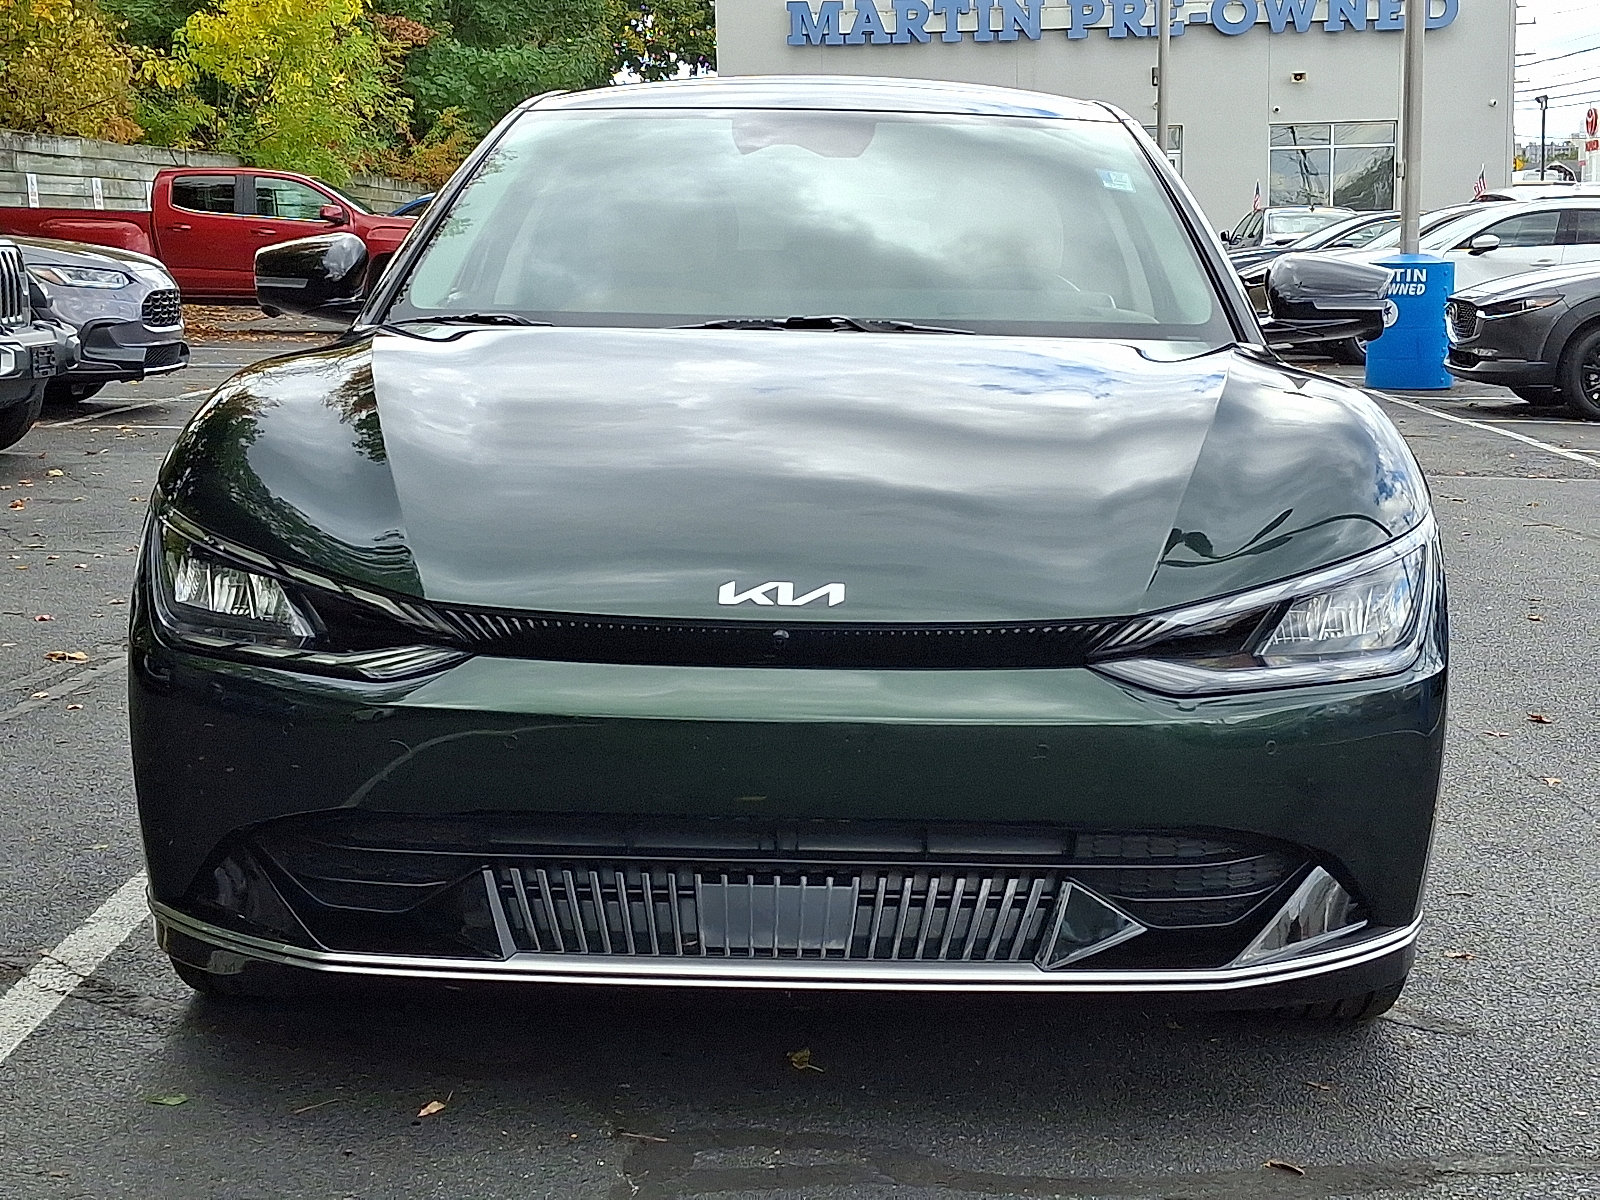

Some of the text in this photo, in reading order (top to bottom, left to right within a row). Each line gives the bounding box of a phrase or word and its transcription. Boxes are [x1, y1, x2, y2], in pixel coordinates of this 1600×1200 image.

[787, 0, 1460, 45] MARTIN PRE-OWNED
[718, 580, 846, 607] KIA
